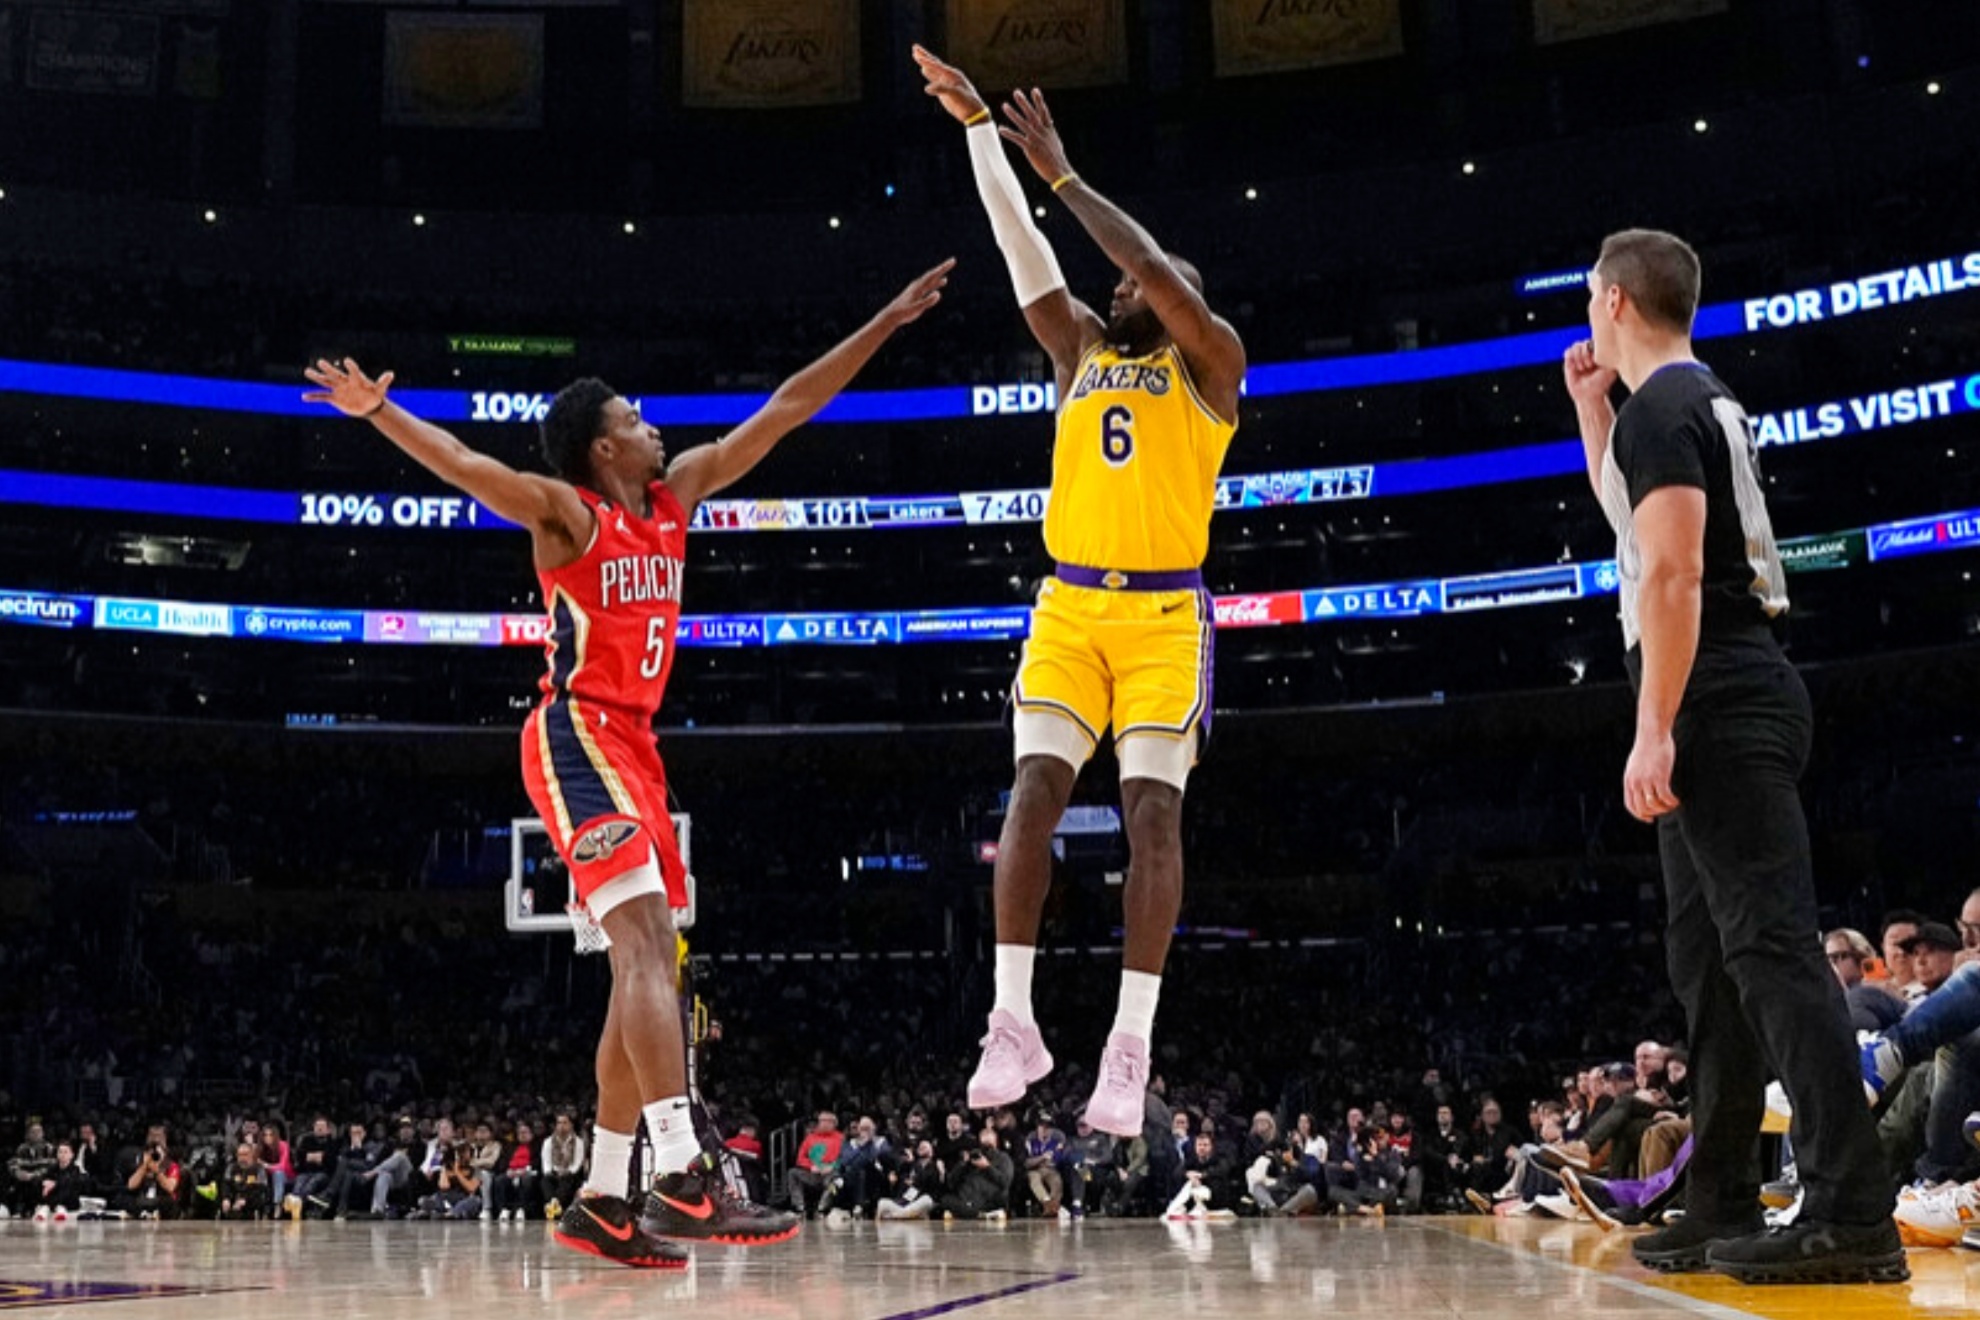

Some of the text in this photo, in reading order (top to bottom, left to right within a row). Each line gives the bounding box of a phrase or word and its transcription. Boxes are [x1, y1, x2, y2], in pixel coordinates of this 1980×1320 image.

[1744, 294, 1824, 331] FOR
[1073, 363, 1170, 398] LAKERS
[1849, 380, 1956, 429] VISIT
[1101, 404, 1133, 464] 6
[301, 493, 384, 525] 10%
[392, 496, 462, 527] OFF
[812, 501, 856, 526] 101
[889, 503, 944, 519] Lakers
[976, 493, 1043, 520] 7:40
[111, 602, 223, 628] UCLA Health
[1344, 587, 1432, 611] DELTA
[269, 615, 352, 633] crypto.com
[703, 621, 759, 638] ULTRA
[805, 619, 888, 638] DELTA
[907, 617, 1024, 632] AMERICAN EXPRESS
[640, 616, 665, 679] 5
